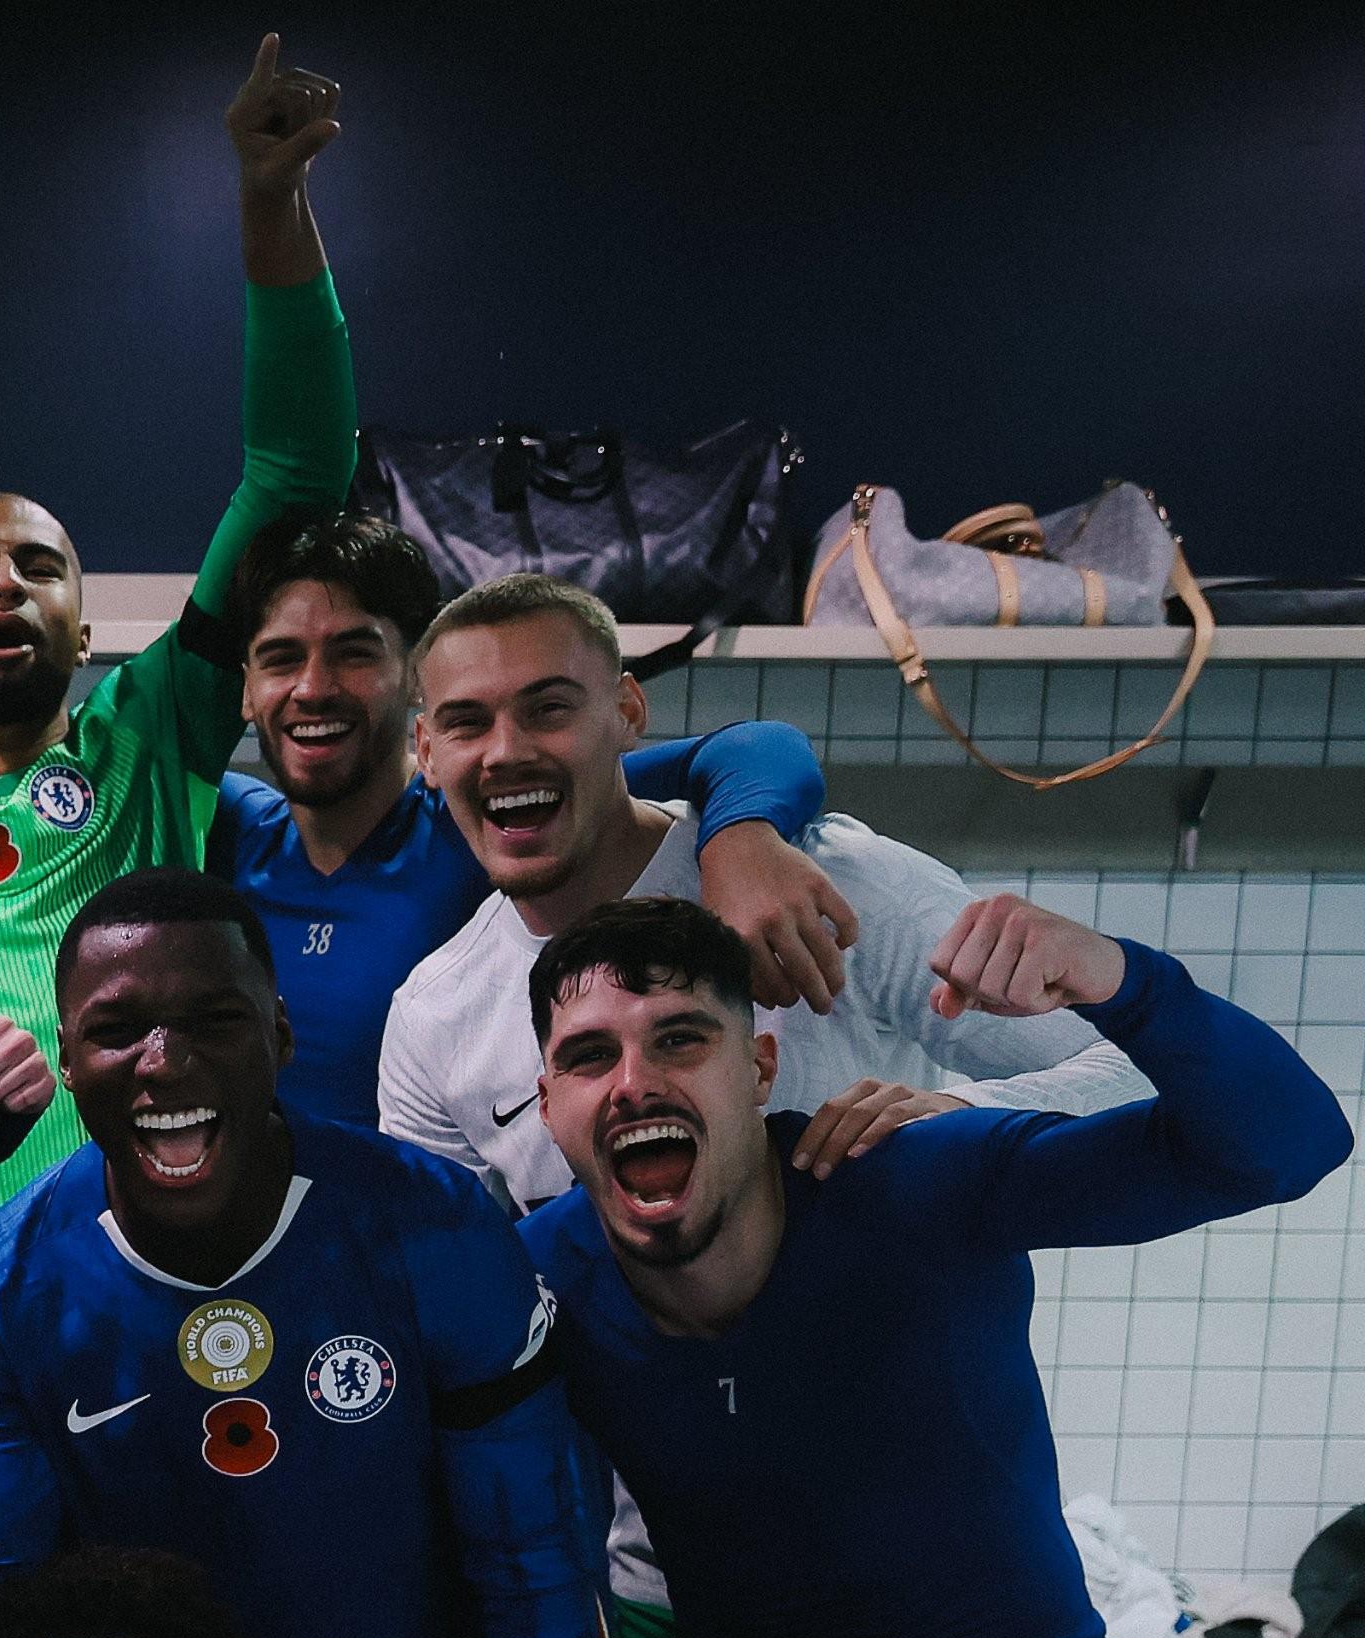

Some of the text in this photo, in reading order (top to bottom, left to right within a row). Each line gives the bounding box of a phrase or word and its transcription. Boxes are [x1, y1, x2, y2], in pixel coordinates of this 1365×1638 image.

[302, 923, 334, 955] 38
[186, 1307, 266, 1362] WORLD CHAMPIONS
[317, 1338, 376, 1362] CHELSEA
[212, 1368, 249, 1386] FIFA
[718, 1377, 737, 1414] 7
